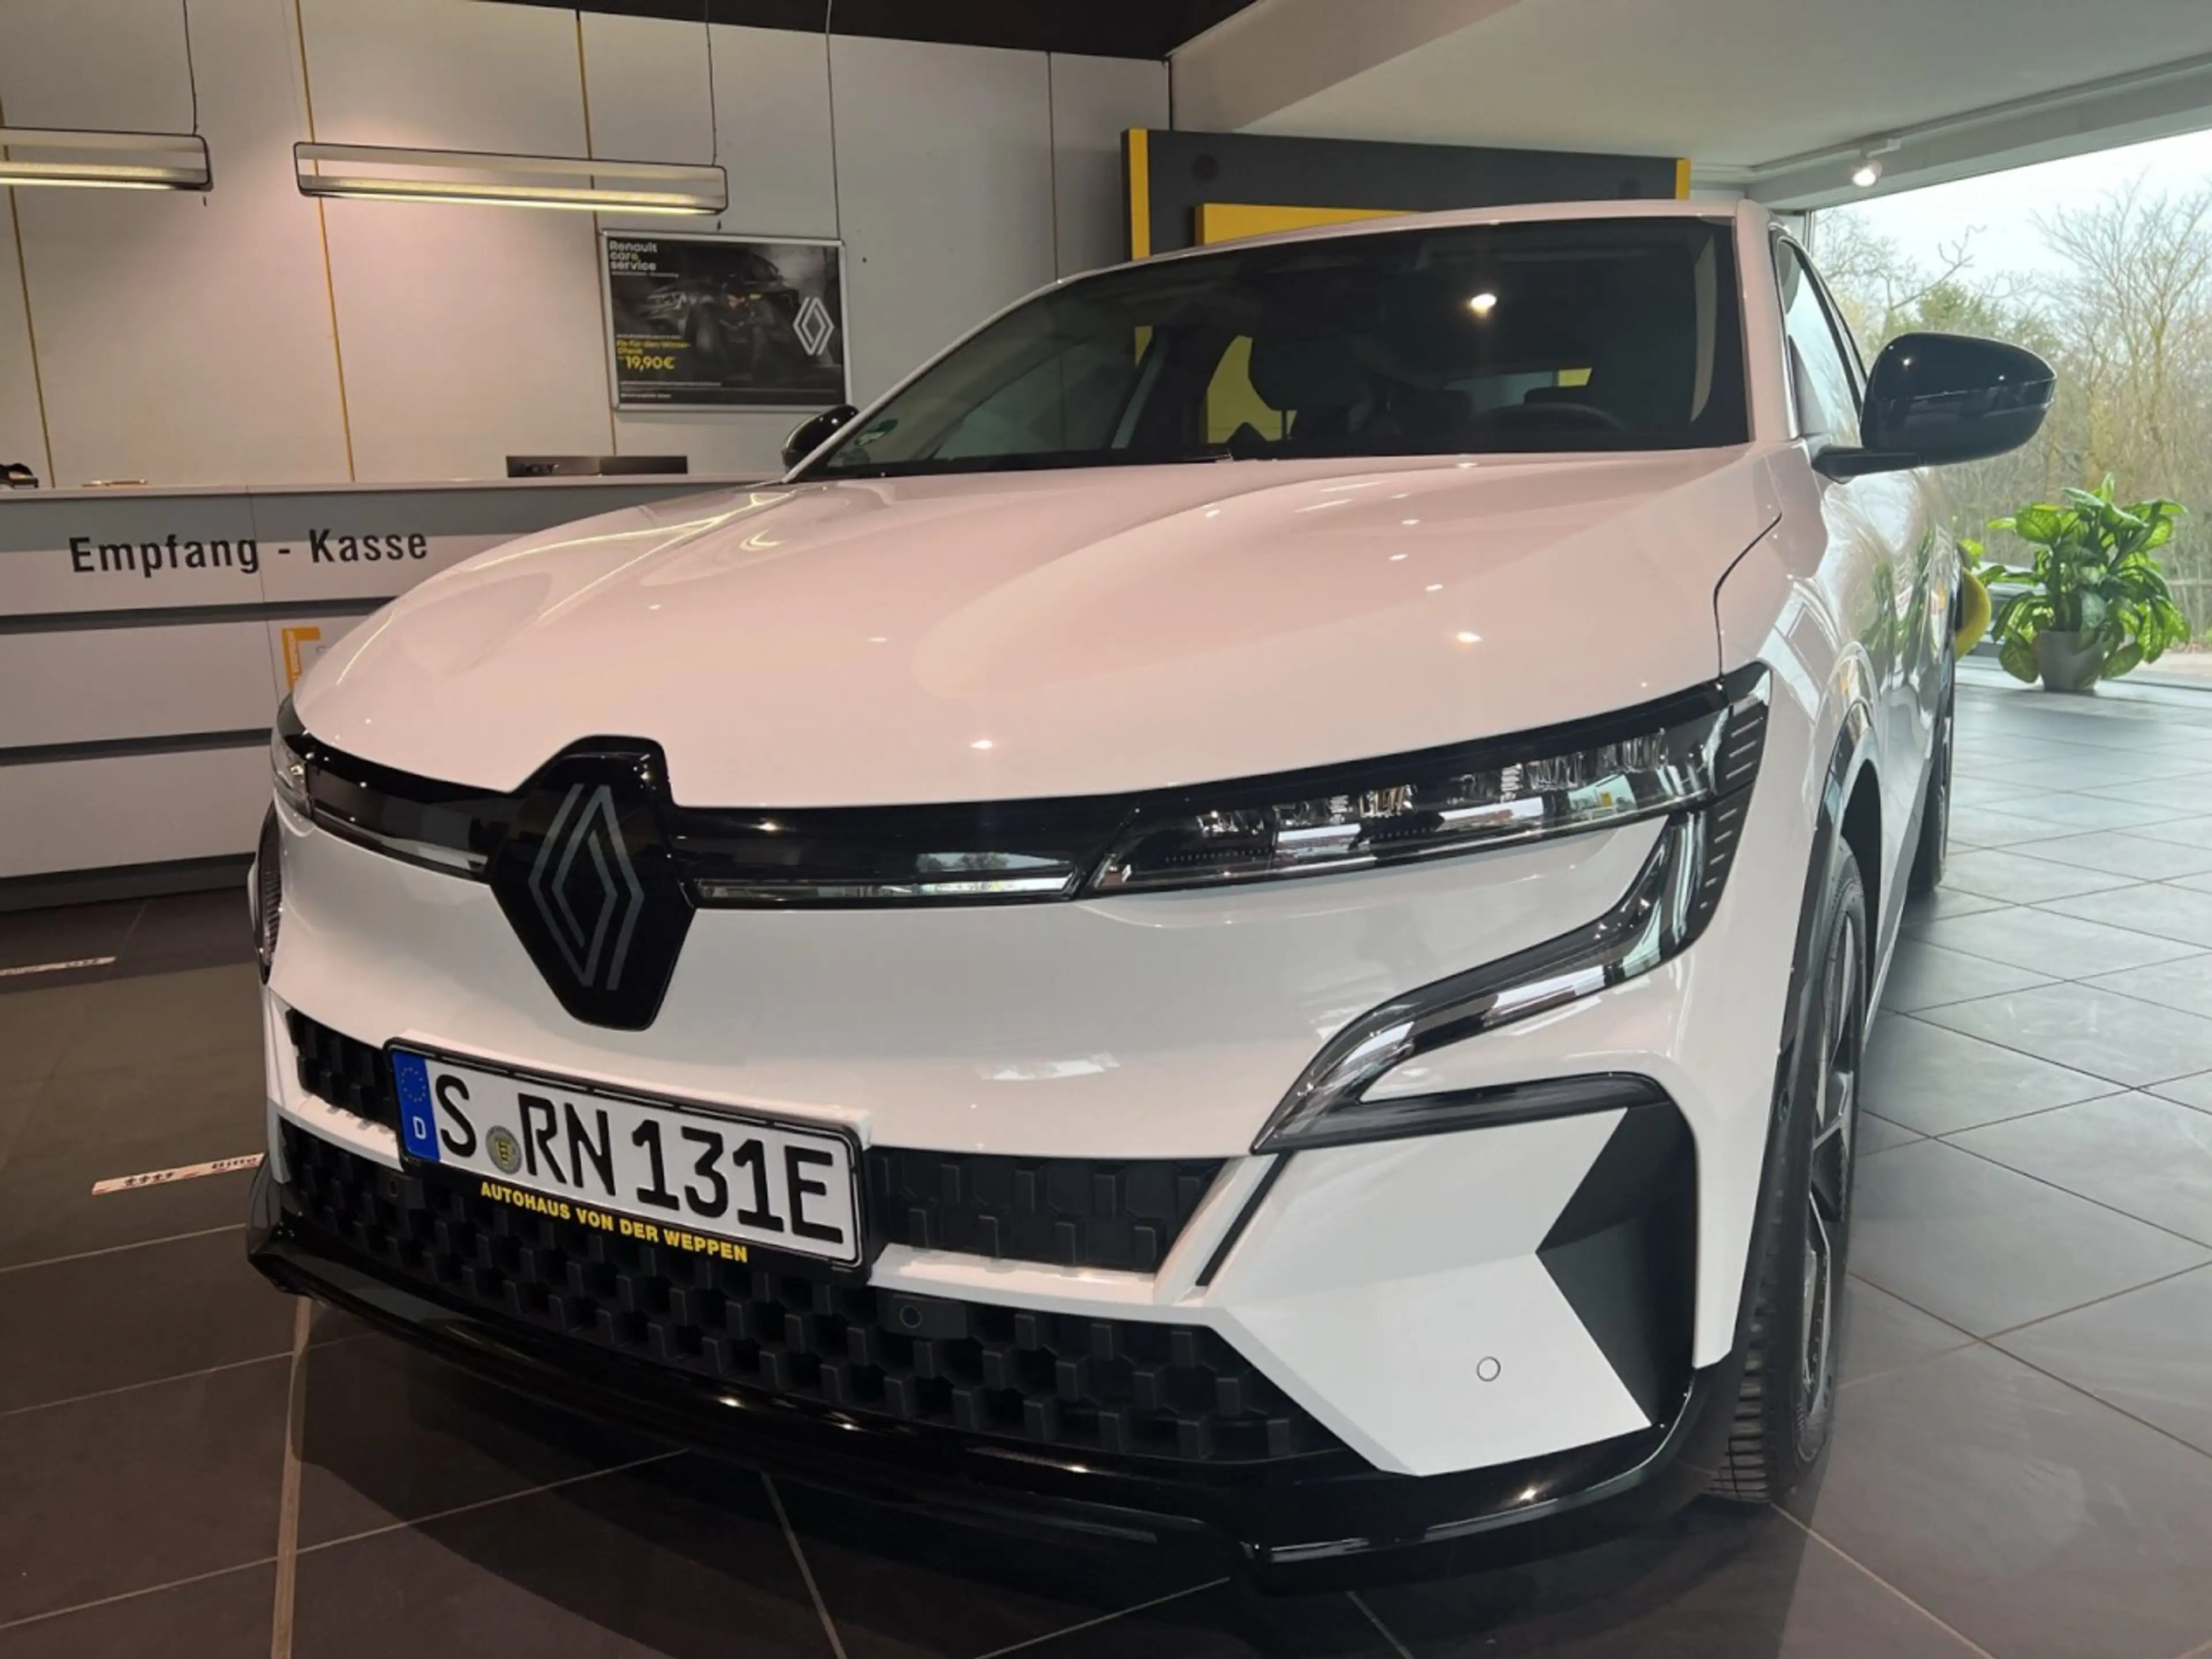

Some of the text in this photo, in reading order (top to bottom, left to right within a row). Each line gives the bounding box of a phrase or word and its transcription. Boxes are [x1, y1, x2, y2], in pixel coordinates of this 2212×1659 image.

[609, 240, 657, 253] Renault
[610, 252, 639, 261] care
[610, 259, 657, 271] service
[625, 355, 676, 372] 19,90€
[69, 533, 259, 578] Empfang
[309, 528, 427, 563] Kasse
[412, 1116, 426, 1139] D
[435, 1074, 844, 1244] S RN 131E
[480, 1181, 748, 1263] AUTOHAUS VON DER WEPPEN
